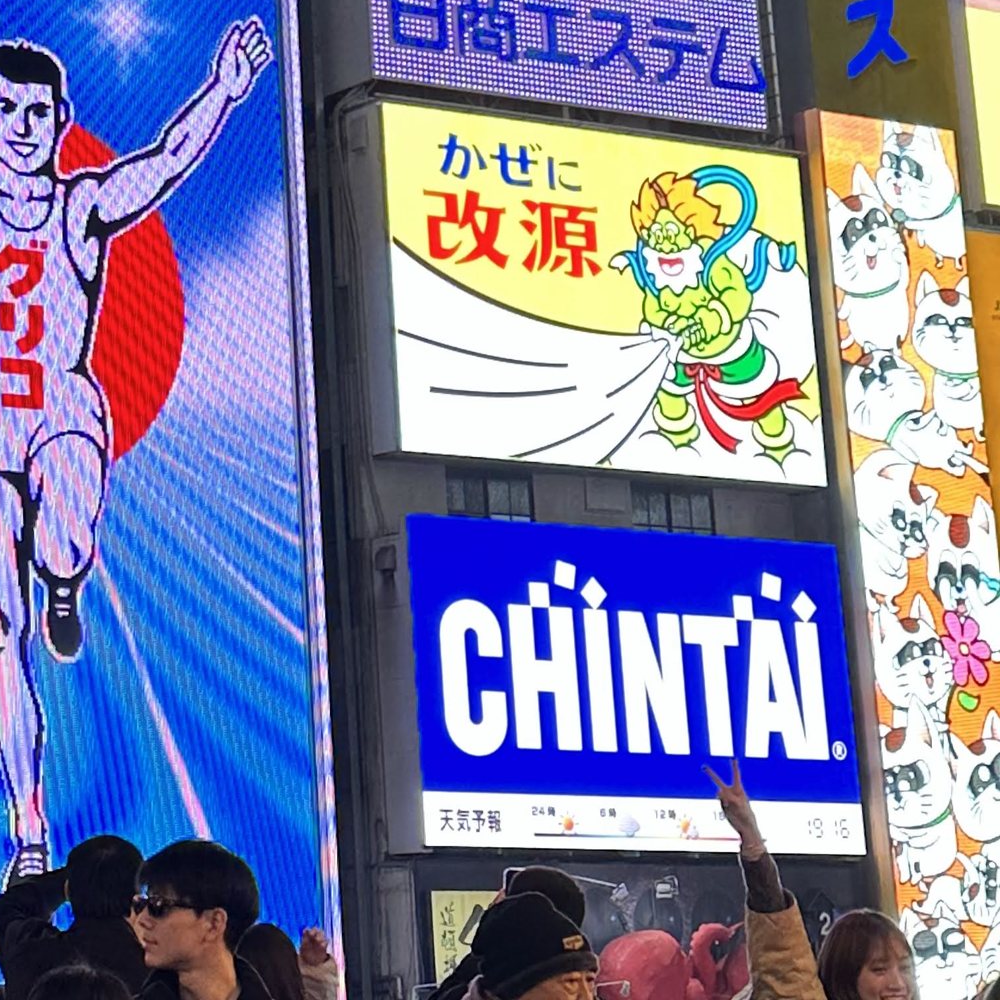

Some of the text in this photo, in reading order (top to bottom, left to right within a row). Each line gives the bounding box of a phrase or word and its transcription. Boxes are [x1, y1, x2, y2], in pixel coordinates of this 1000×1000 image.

[437, 133, 583, 193] かぜに
[423, 189, 602, 278] 改源
[439, 808, 502, 832] 天気予報
